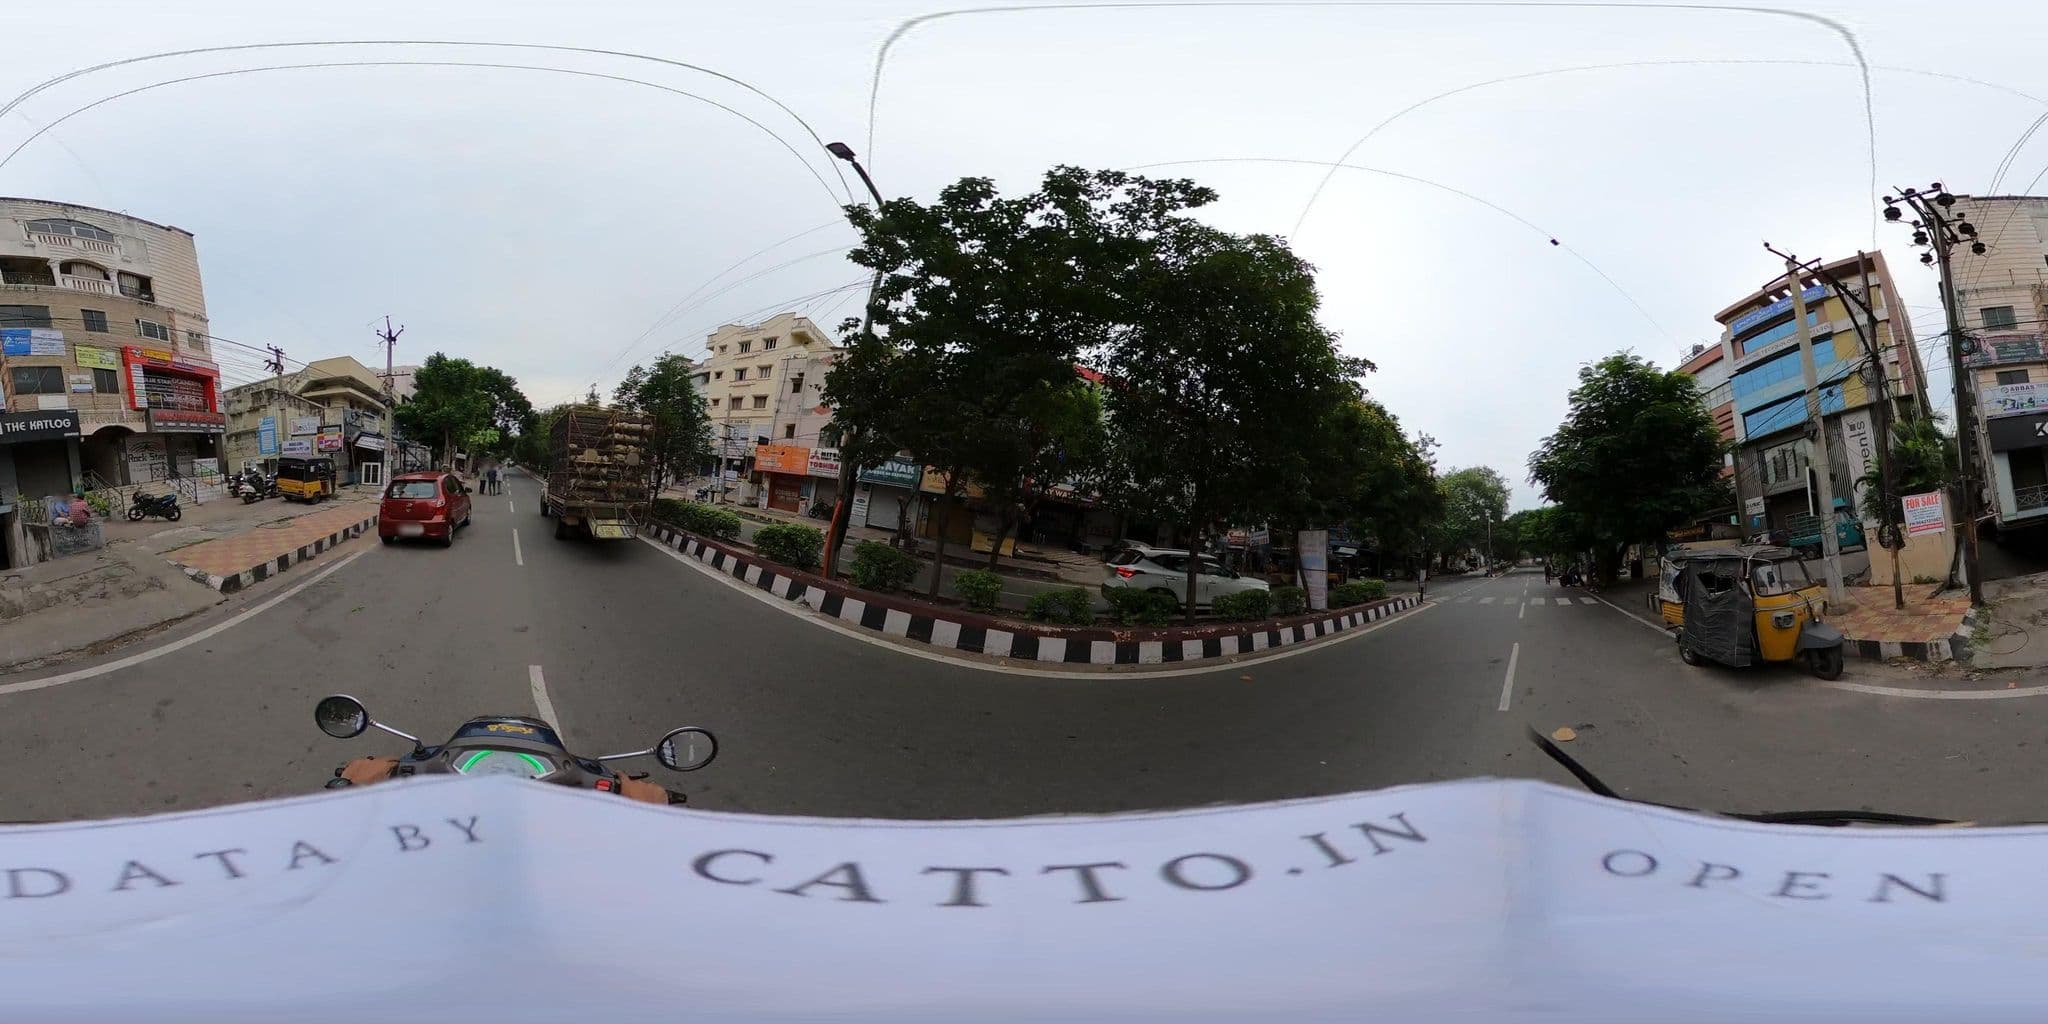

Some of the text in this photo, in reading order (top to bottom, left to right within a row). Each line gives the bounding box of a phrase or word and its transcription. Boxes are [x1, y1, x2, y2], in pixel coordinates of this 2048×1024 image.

[5, 421, 26, 432] THE
[29, 418, 72, 431] KATLOG
[128, 452, 167, 463] Rock Star
[809, 461, 840, 471] TOSHIBA
[1906, 494, 1938, 509] FOR SALE
[6, 810, 1430, 908] DATA BY CATTO.IN
[1602, 848, 1948, 903] OPEN
